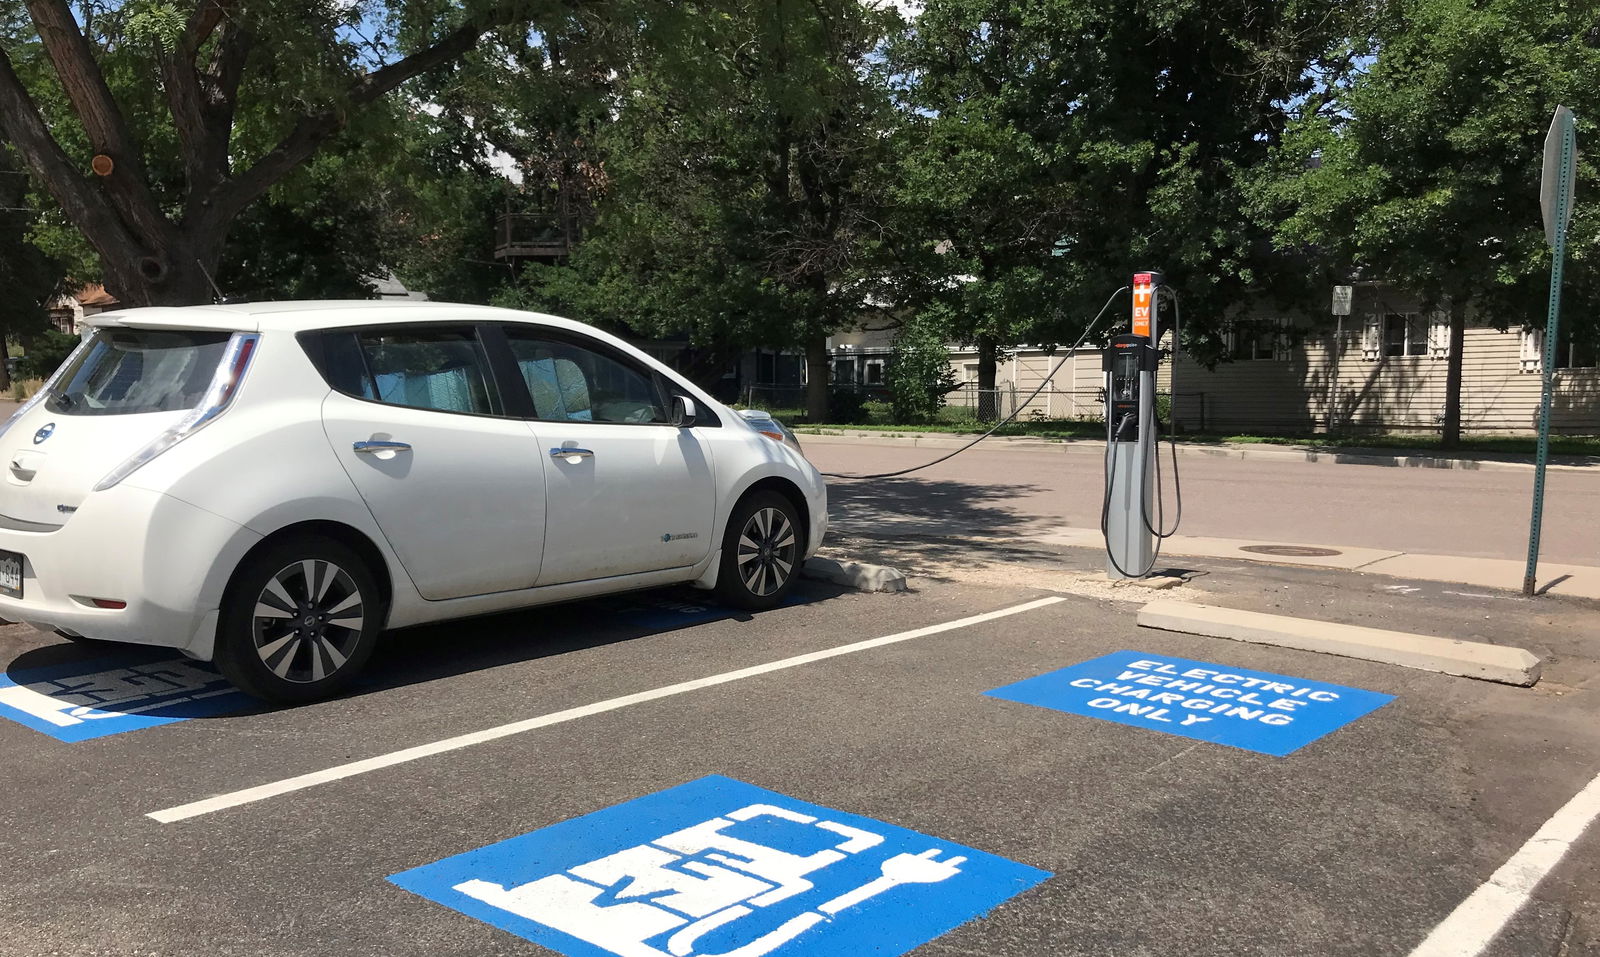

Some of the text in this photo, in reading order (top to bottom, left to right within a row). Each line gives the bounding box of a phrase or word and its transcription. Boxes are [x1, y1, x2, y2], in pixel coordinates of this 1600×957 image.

[1135, 306, 1150, 317] EV
[1115, 670, 1308, 711] VEHICLE
[1126, 659, 1340, 702] ELECTRIC
[1069, 678, 1294, 726] CHARGING
[1086, 697, 1213, 726] ONLY
